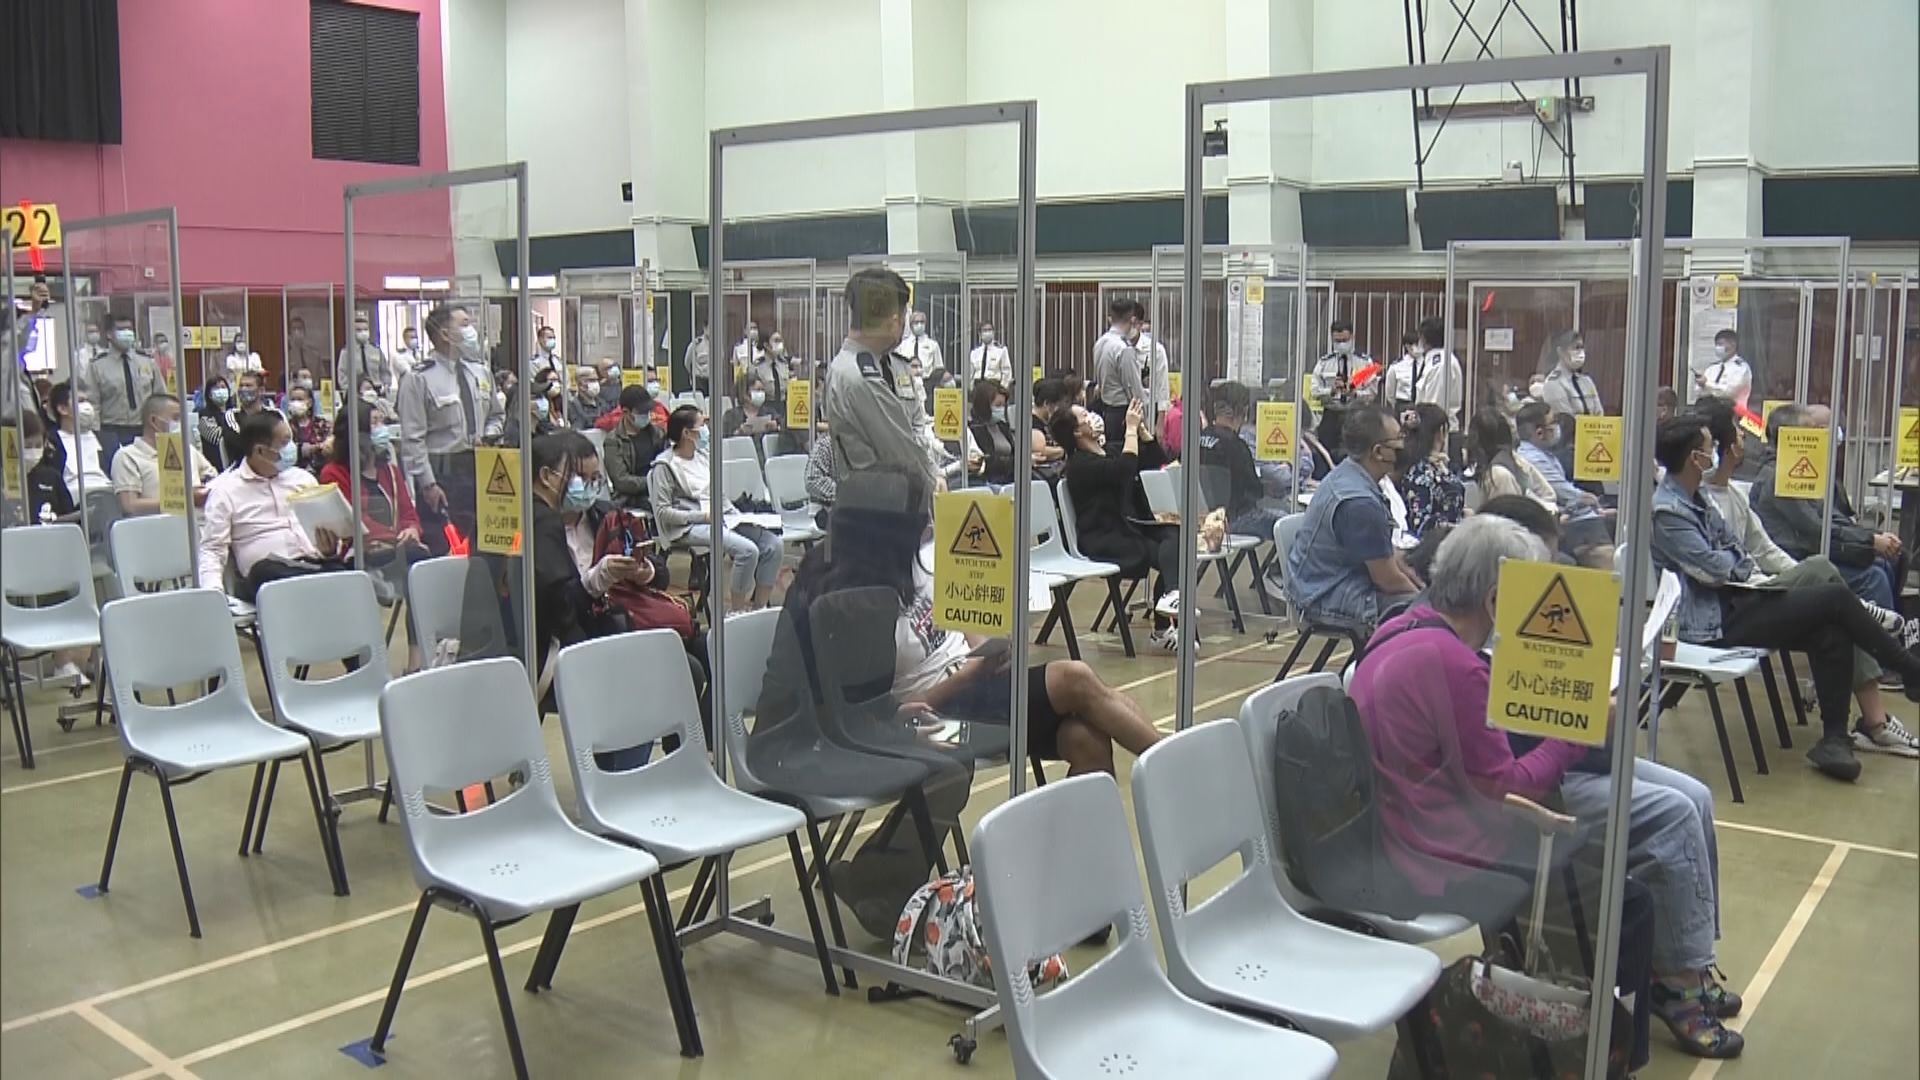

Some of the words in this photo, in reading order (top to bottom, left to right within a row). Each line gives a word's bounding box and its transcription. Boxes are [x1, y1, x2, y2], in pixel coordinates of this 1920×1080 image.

[6, 208, 57, 247] 22
[484, 534, 517, 547] CAUTIO
[955, 558, 979, 568] WATCH
[980, 560, 997, 569] YOUR
[945, 608, 1003, 627] CAUTION
[1521, 641, 1556, 656] WATCH
[1559, 646, 1585, 659] YOUR
[1506, 670, 1595, 703] 小心絆腳
[1505, 702, 1590, 730] CAUTION
